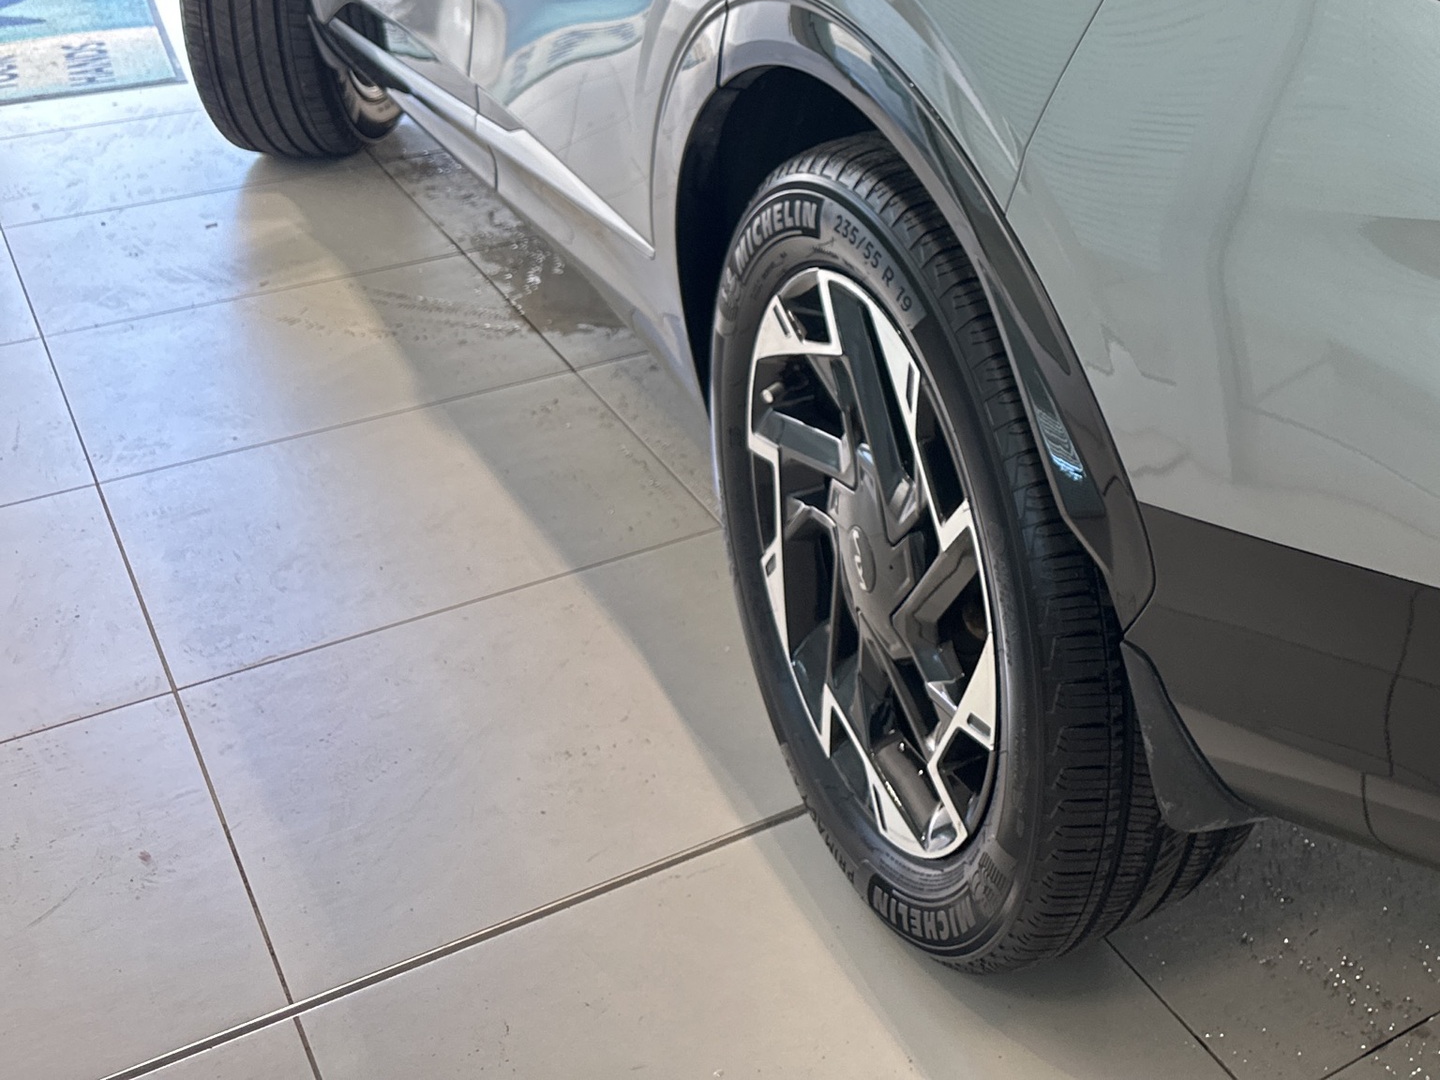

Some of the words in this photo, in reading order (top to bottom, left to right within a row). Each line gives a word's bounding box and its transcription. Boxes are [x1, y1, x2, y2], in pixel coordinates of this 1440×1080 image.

[733, 200, 817, 275] MICHELIN
[832, 214, 882, 269] 235/55
[882, 265, 895, 288] R
[896, 286, 913, 312] 19
[872, 886, 976, 941] MICHELIN
